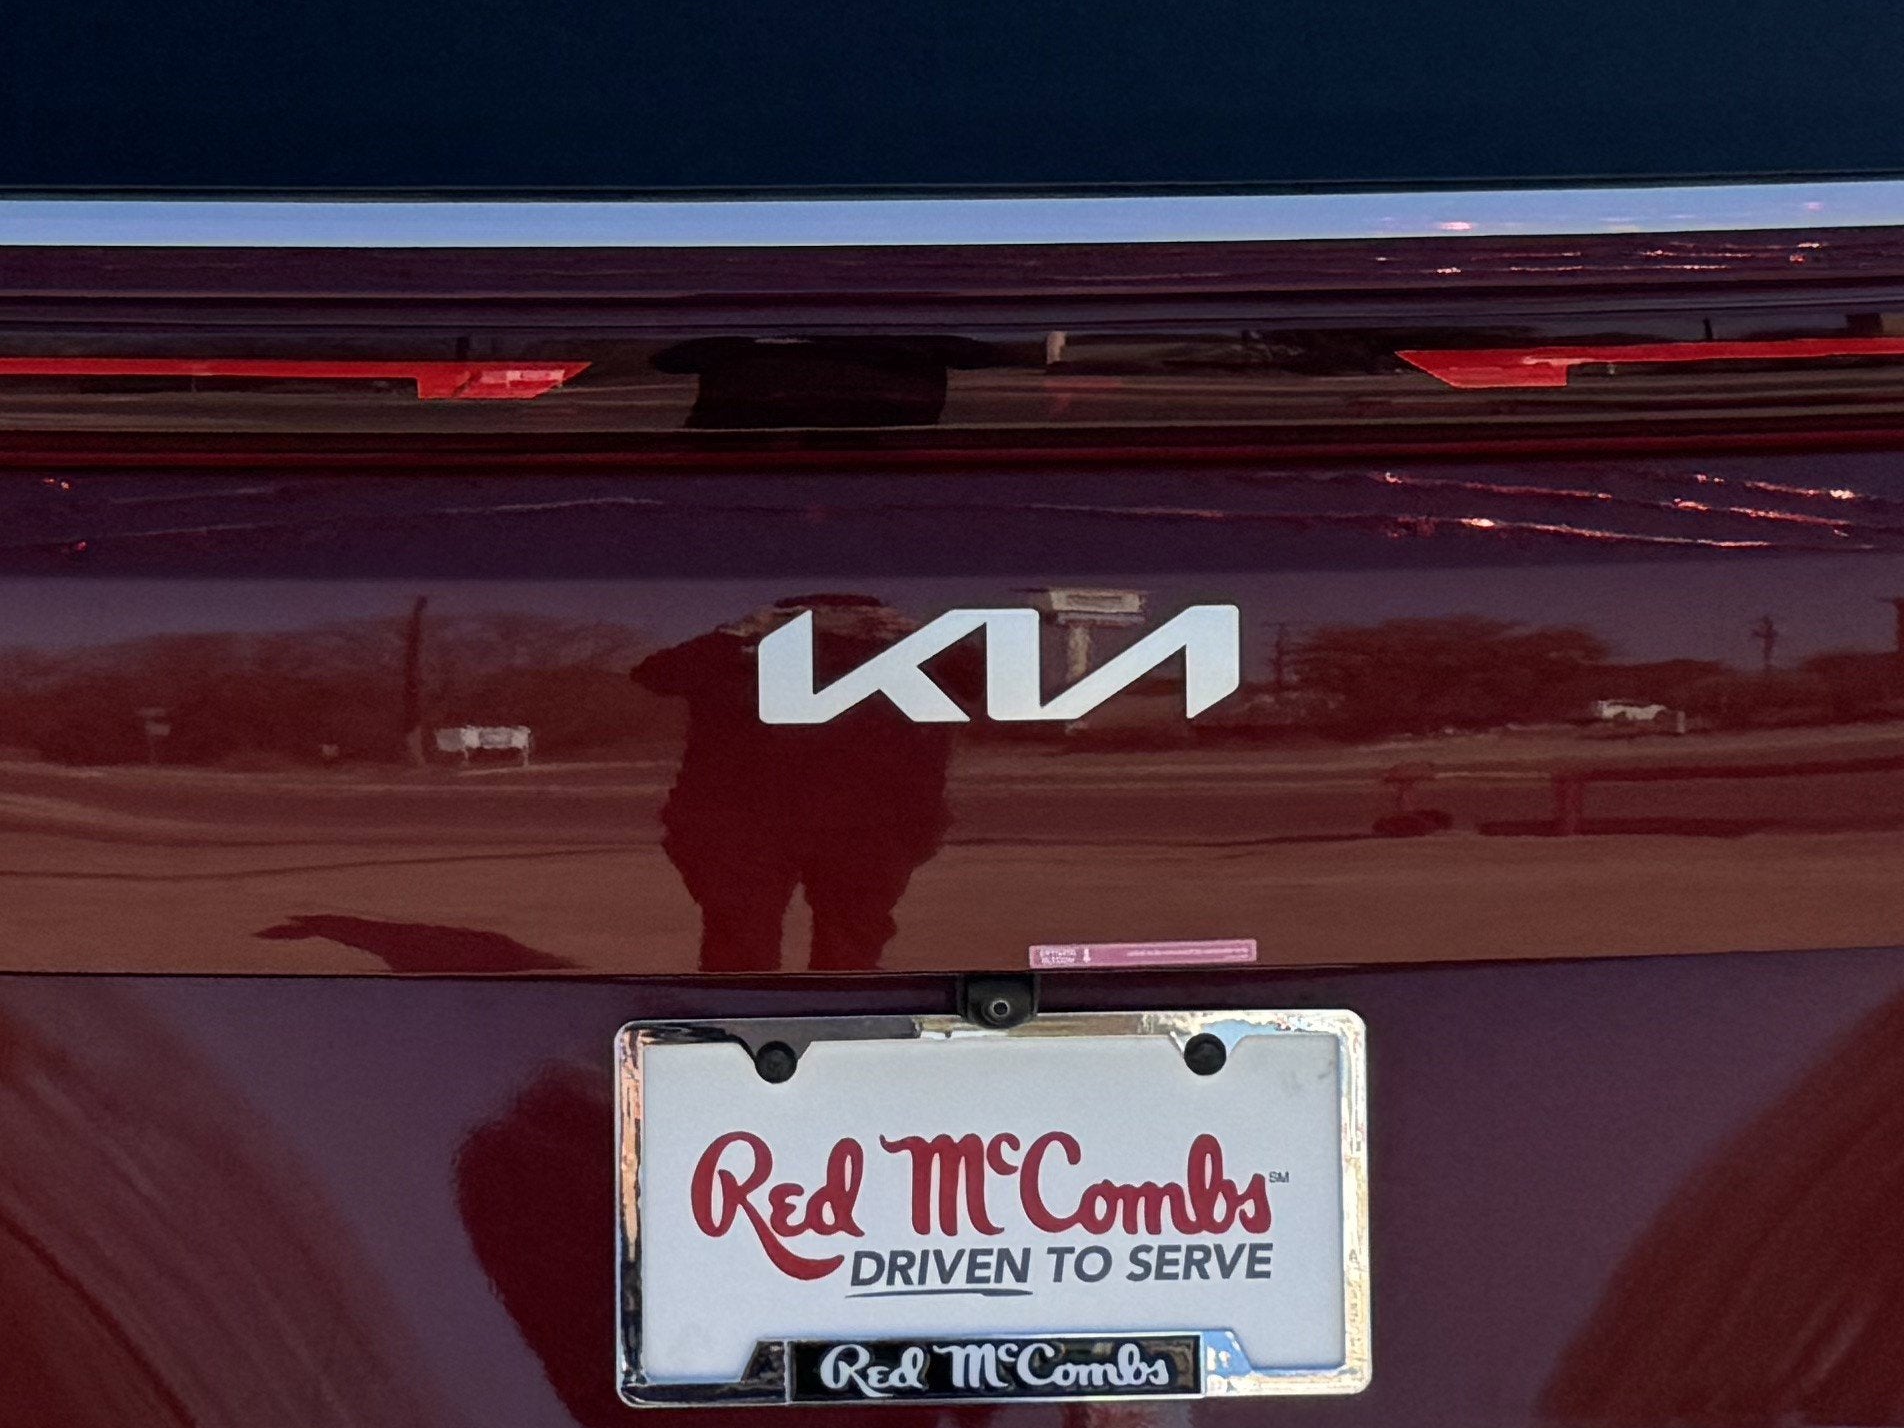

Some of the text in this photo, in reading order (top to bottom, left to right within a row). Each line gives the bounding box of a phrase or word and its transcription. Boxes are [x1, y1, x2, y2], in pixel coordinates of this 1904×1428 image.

[758, 605, 1239, 724] KIA
[690, 1130, 865, 1281] Red
[879, 1130, 1272, 1235] McCombs
[850, 1242, 1274, 1287] DRIVEN TO SERVE
[819, 1342, 1170, 1398] Red McCombs
